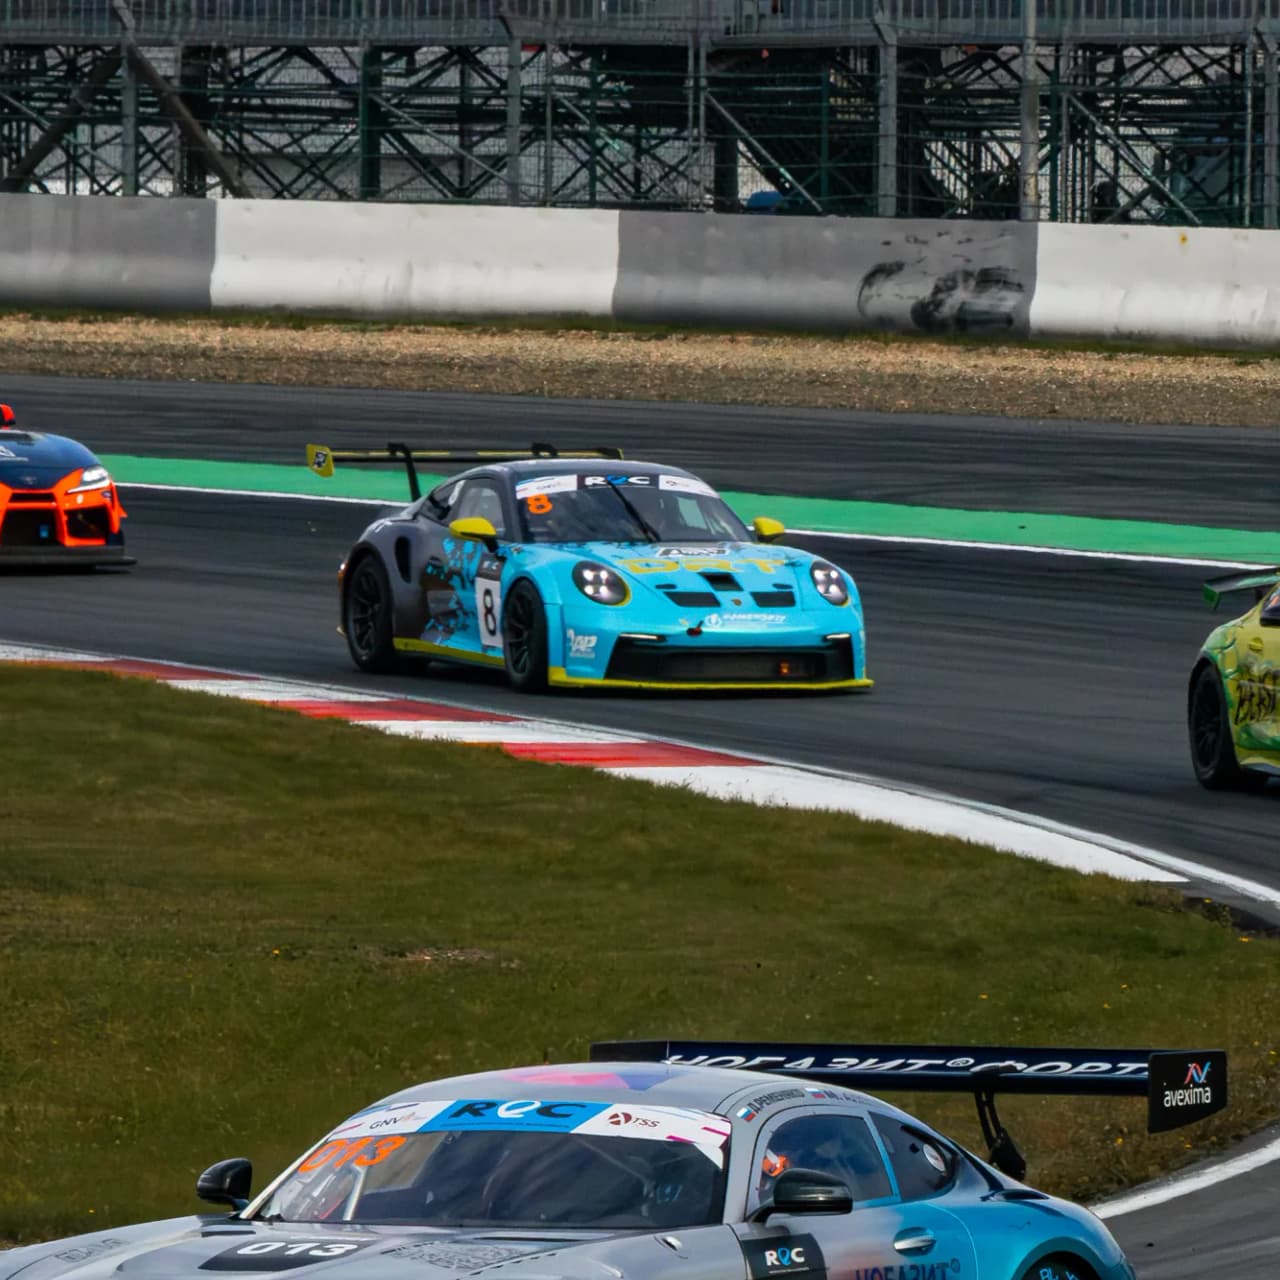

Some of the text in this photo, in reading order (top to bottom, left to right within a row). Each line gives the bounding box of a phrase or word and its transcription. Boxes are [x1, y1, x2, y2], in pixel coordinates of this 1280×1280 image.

[527, 494, 553, 514] 8
[483, 588, 496, 636] 8
[1164, 1084, 1211, 1107] avexima
[370, 1117, 401, 1130] GNV
[632, 1115, 660, 1128] TSS
[298, 1135, 407, 1173] 013
[237, 1242, 358, 1256] 013
